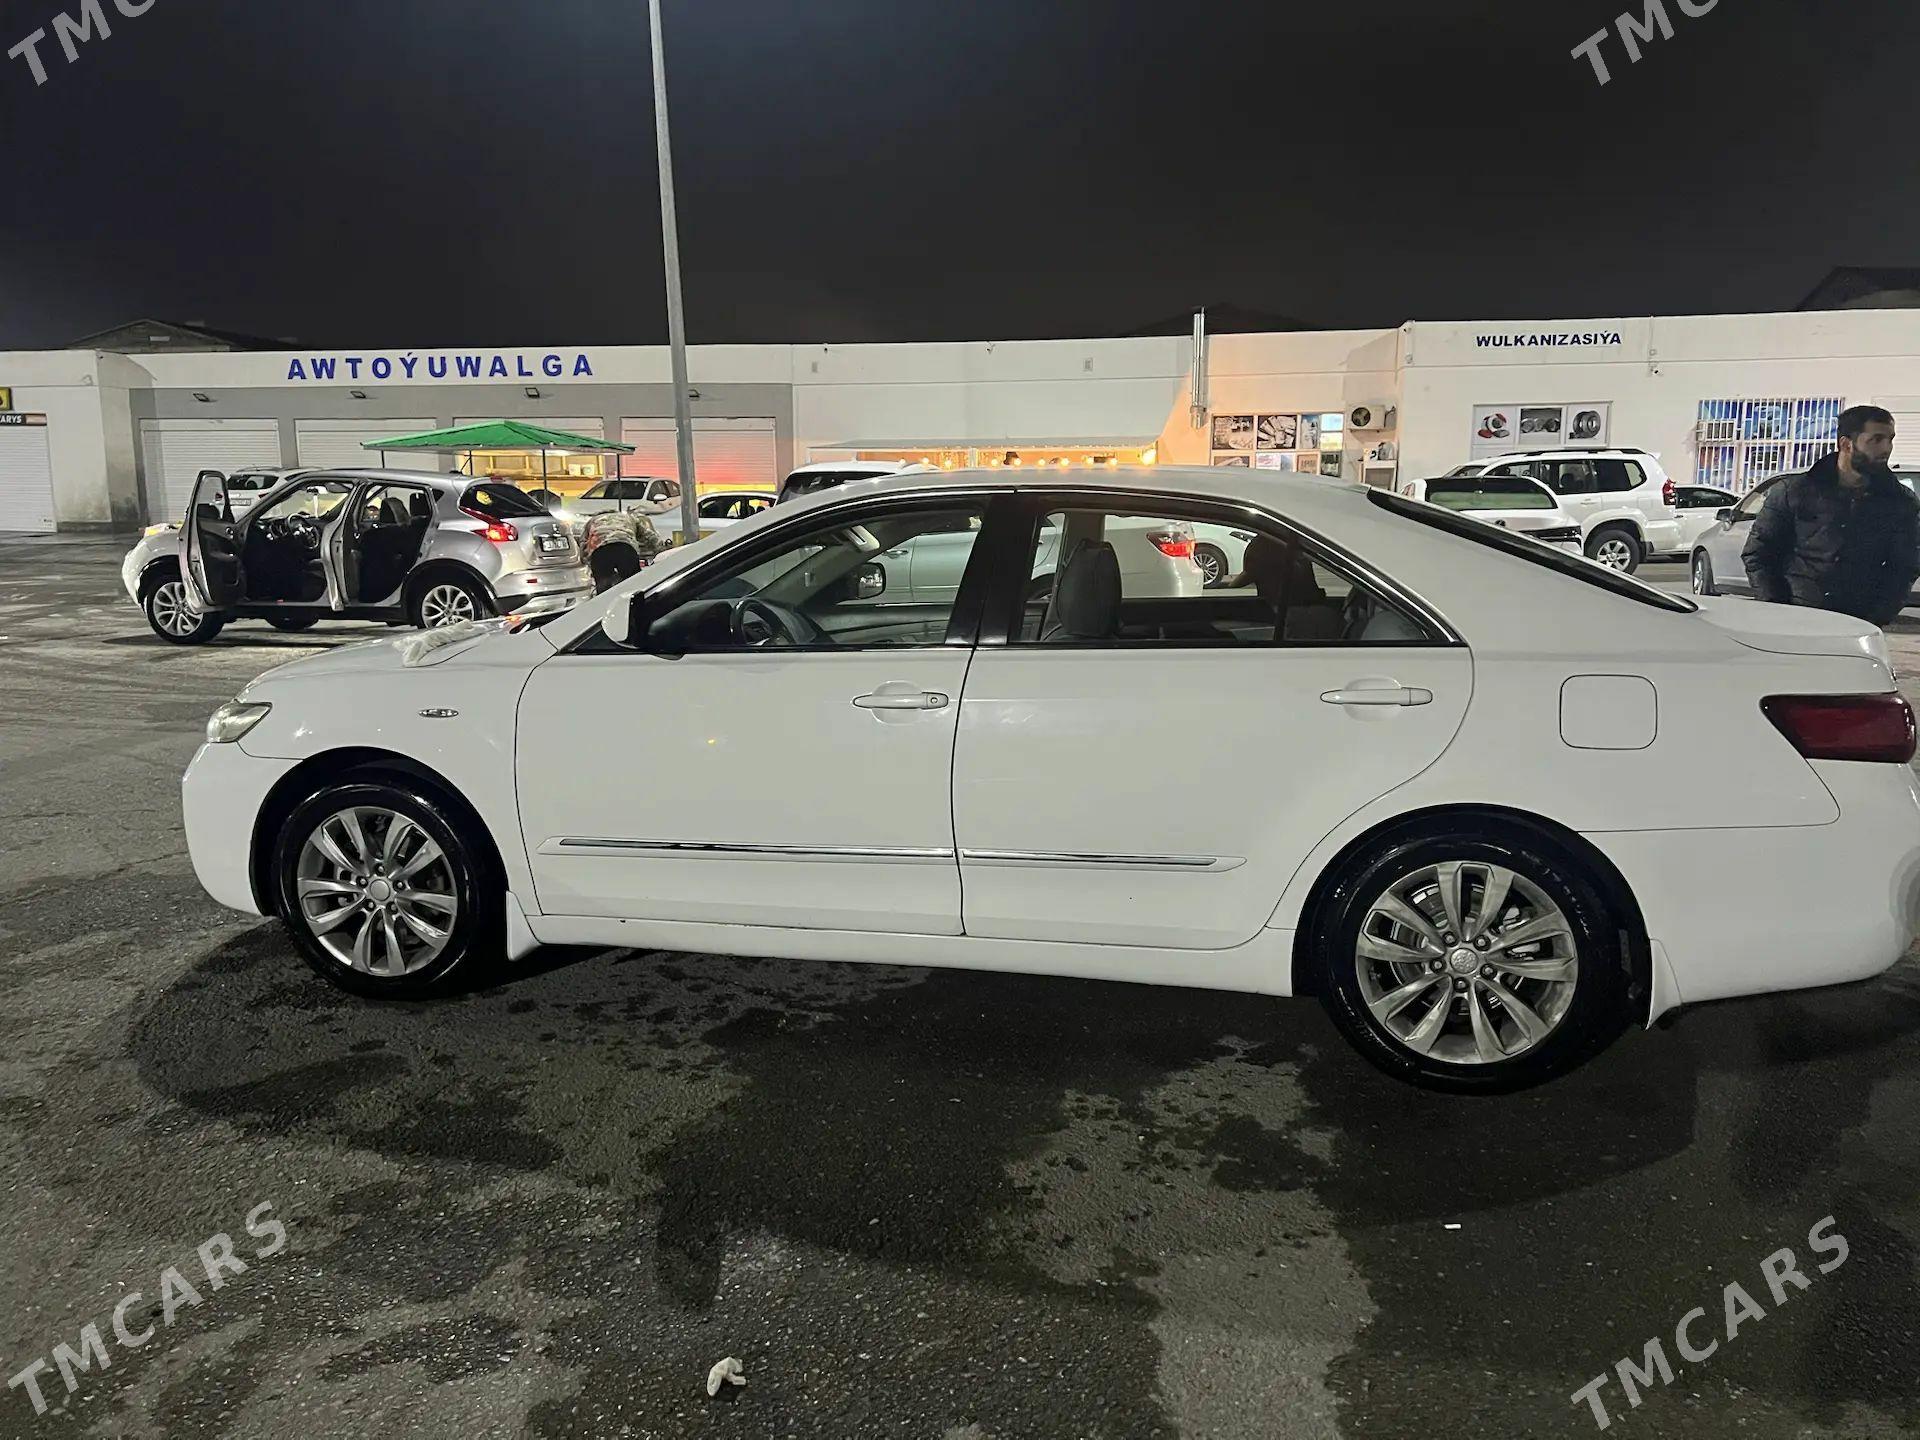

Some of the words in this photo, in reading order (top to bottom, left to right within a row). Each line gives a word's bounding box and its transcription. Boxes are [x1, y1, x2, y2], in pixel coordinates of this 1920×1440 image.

[1476, 330, 1621, 347] WULKANIZASIÝA
[287, 352, 593, 380] AWTOÝUWALGA
[0, 415, 22, 424] ARYS
